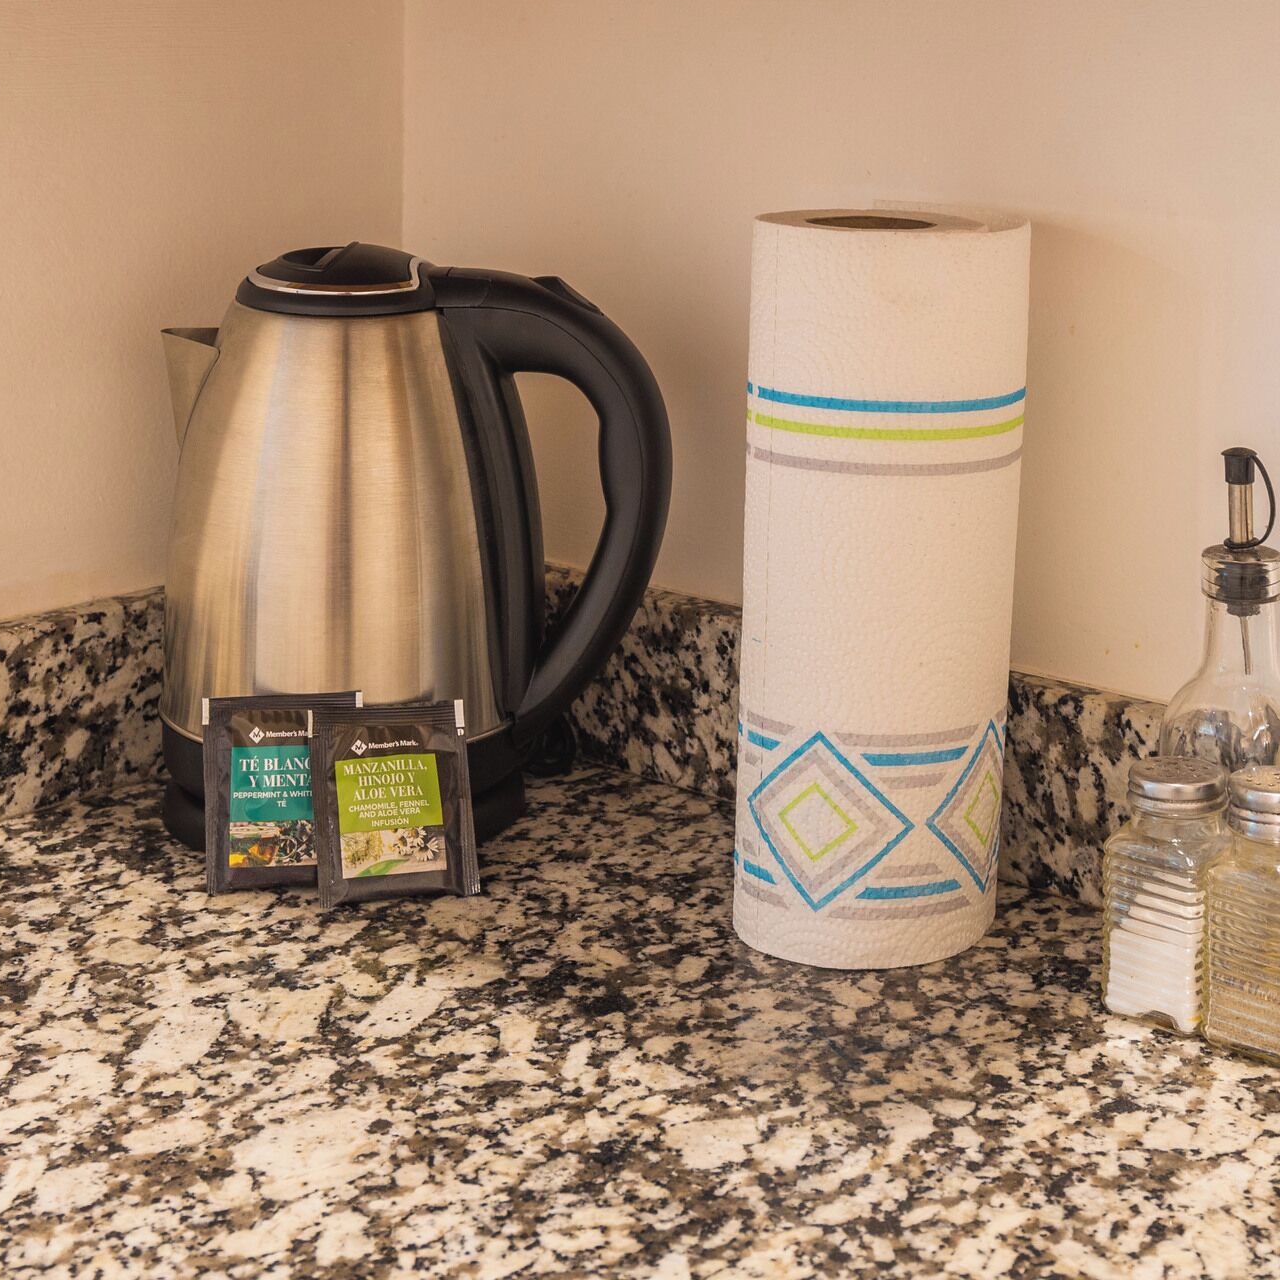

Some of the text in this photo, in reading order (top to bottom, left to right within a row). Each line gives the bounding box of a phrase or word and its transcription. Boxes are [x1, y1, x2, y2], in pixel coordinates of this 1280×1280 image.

[265, 730, 298, 738] Member's
[368, 740, 400, 750] Member's
[239, 755, 260, 772] TÉ
[343, 759, 428, 776] MANZANILLA,
[248, 775, 259, 788] Y
[358, 771, 415, 787] HINOJO Y
[233, 790, 281, 799] PEPPERMINT
[353, 785, 423, 802] ALOE VERA
[349, 799, 429, 813] CHAMOMILE, FENNEL
[359, 806, 421, 819] AND ALOE VERA
[371, 816, 410, 828] INFUSIÓN
